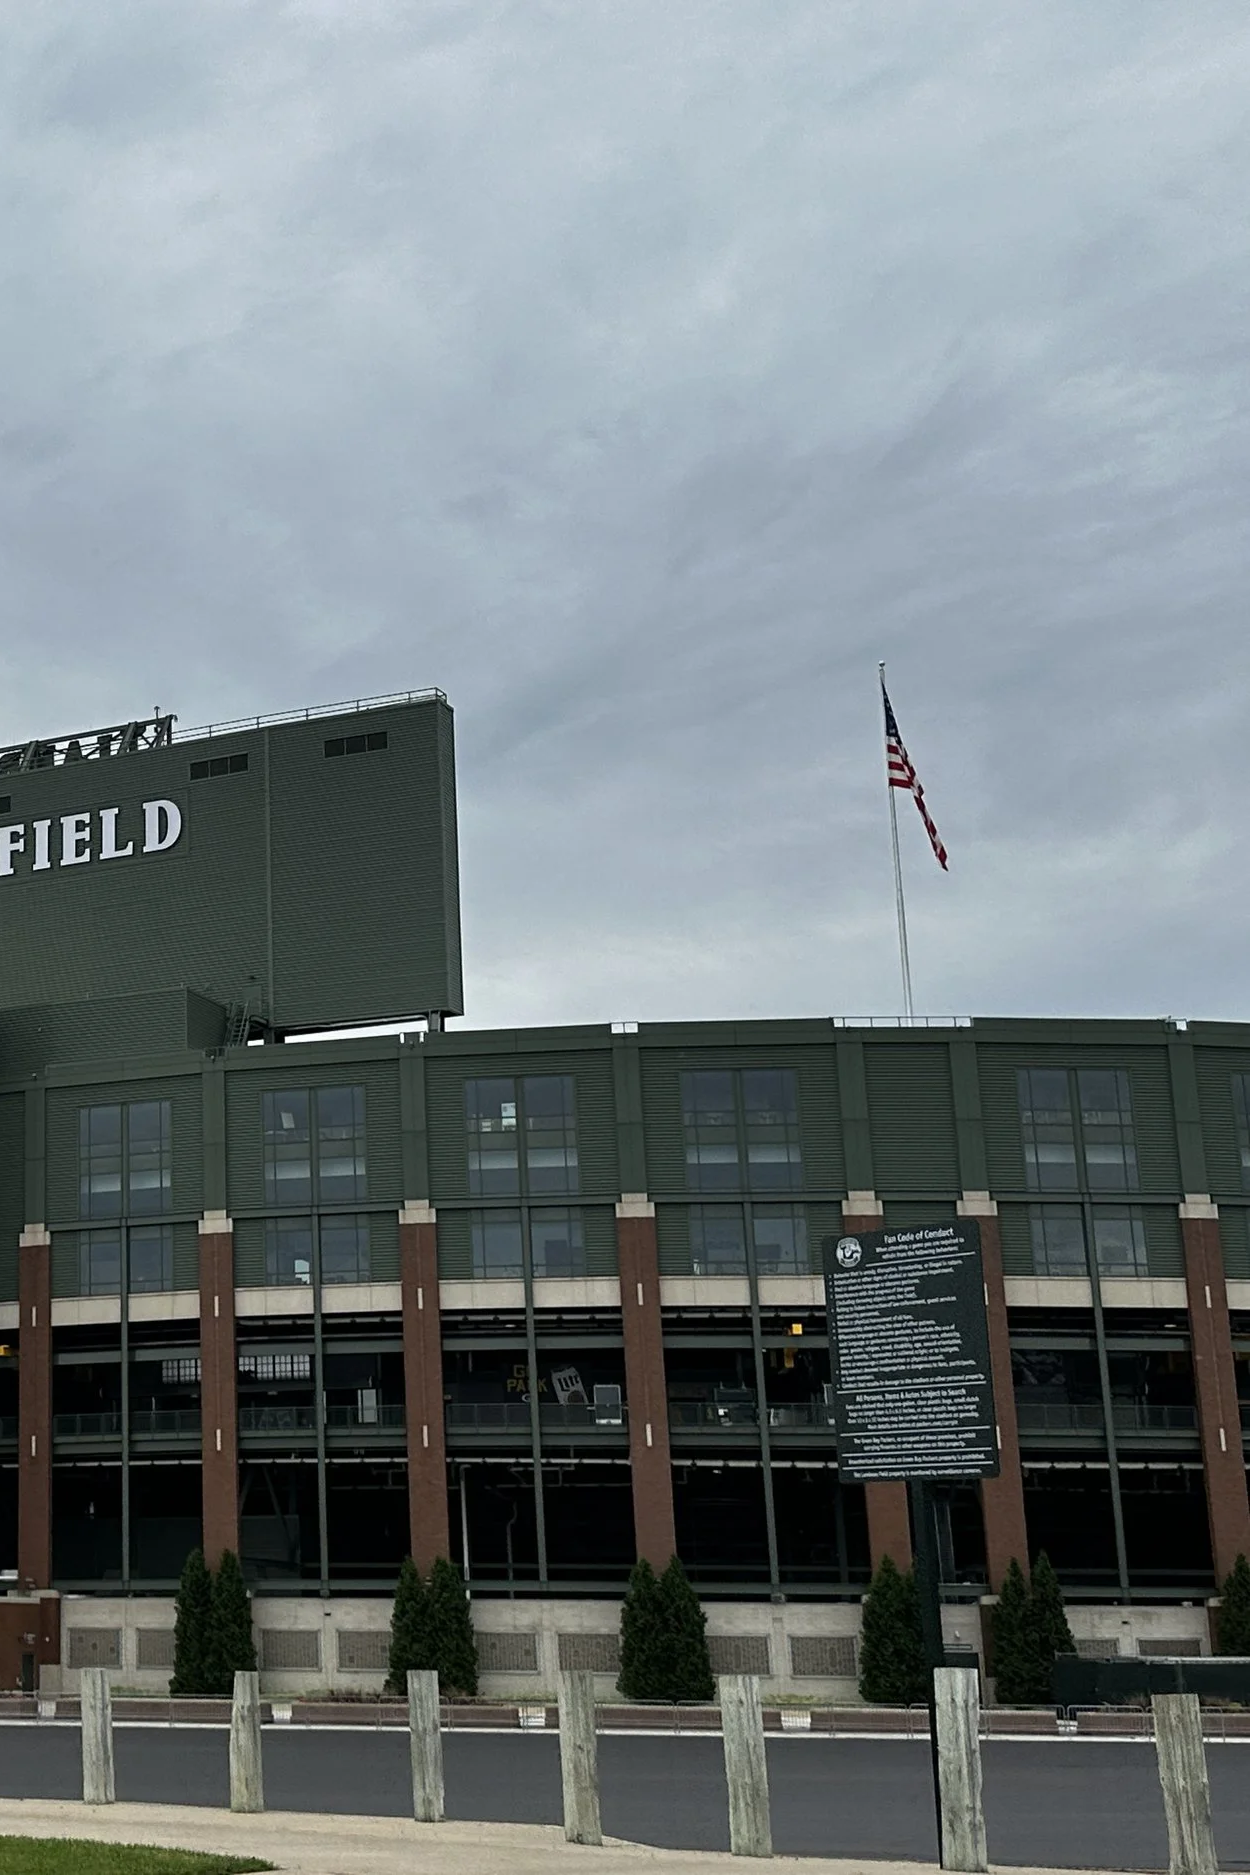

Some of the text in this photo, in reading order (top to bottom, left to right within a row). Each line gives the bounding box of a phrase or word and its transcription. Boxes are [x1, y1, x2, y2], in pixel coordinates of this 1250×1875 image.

[884, 1228, 954, 1244] Fan Code of Conduct
[514, 1364, 529, 1377] G
[506, 1378, 548, 1392] PAK
